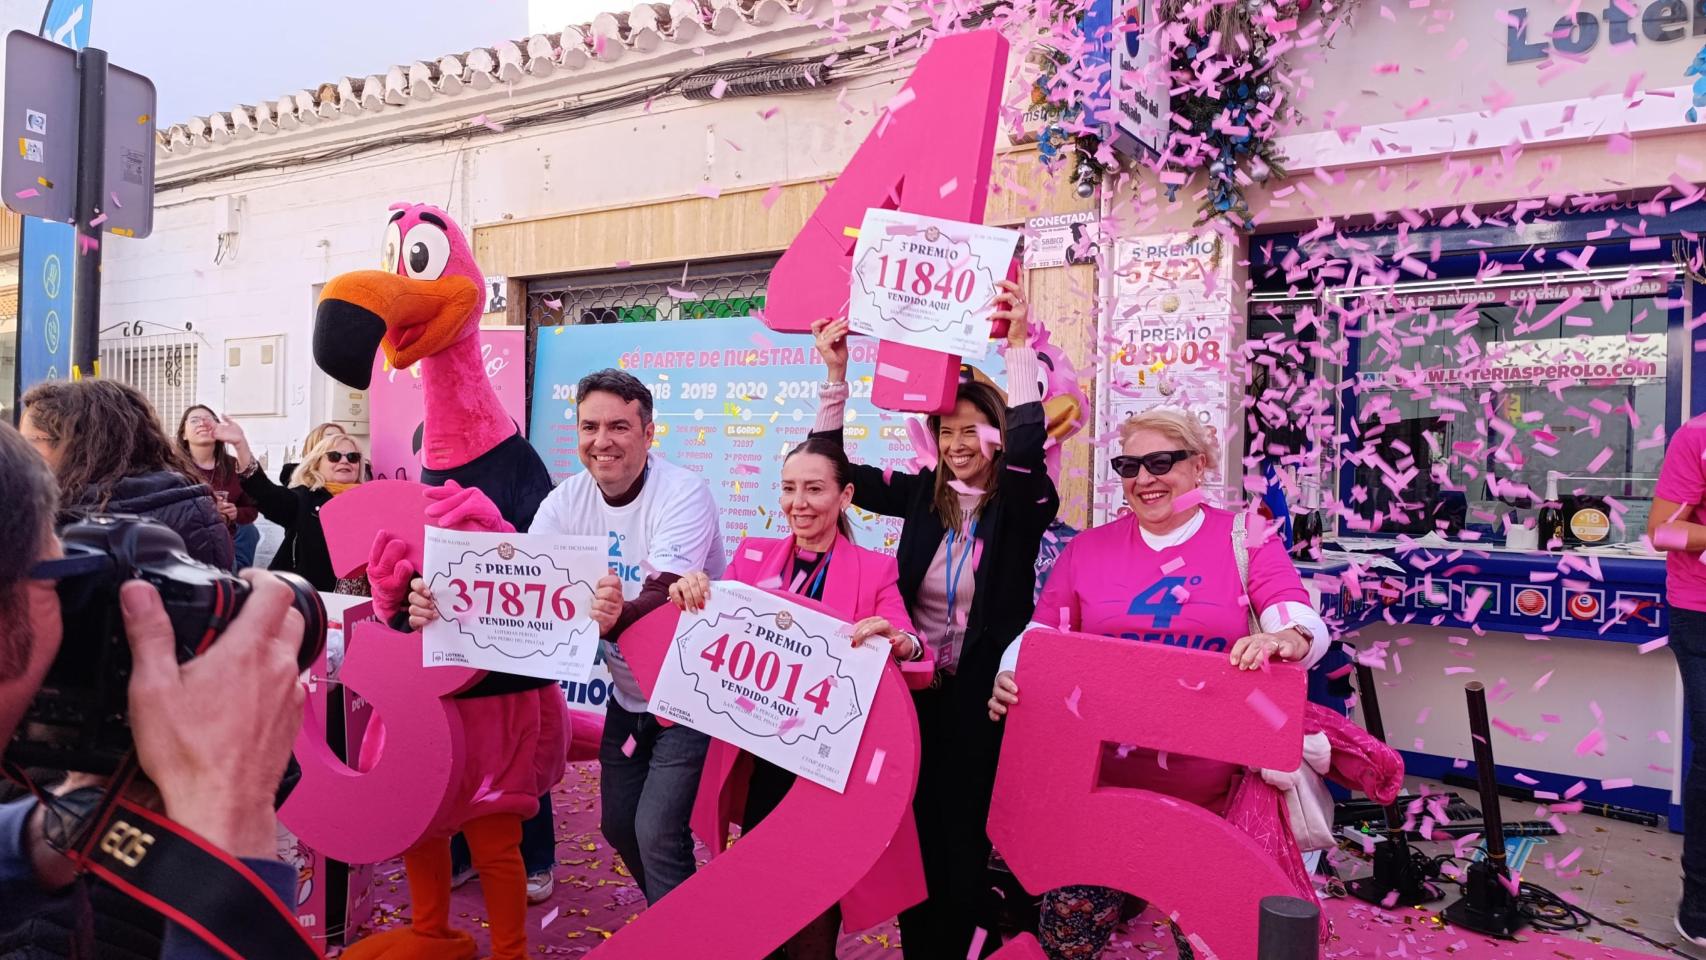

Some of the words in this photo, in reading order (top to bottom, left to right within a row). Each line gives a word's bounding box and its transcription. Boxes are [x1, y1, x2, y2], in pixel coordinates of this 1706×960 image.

[1029, 211, 1095, 228] CONECTADA
[909, 242, 959, 261] PREMIO
[876, 254, 976, 304] 11840
[887, 291, 928, 308] VENDIDO
[1141, 326, 1211, 341] PREMIO
[553, 383, 578, 400] 201
[681, 382, 718, 400] 2019
[726, 381, 768, 399] 2020
[778, 381, 818, 399] 2021
[736, 426, 762, 435] GORDO
[734, 454, 762, 463] PREMIO
[728, 508, 757, 517] PREMIO
[485, 563, 542, 577] PREMIO
[448, 578, 576, 621] 37876
[478, 616, 524, 630] VENDIDO
[526, 621, 553, 632] AQUÍ
[755, 625, 812, 657] PREMIO
[700, 633, 834, 716] 40014
[721, 678, 769, 705] VENDIDO
[770, 700, 799, 717] AQUÍ
[101, 820, 156, 868] EOS
